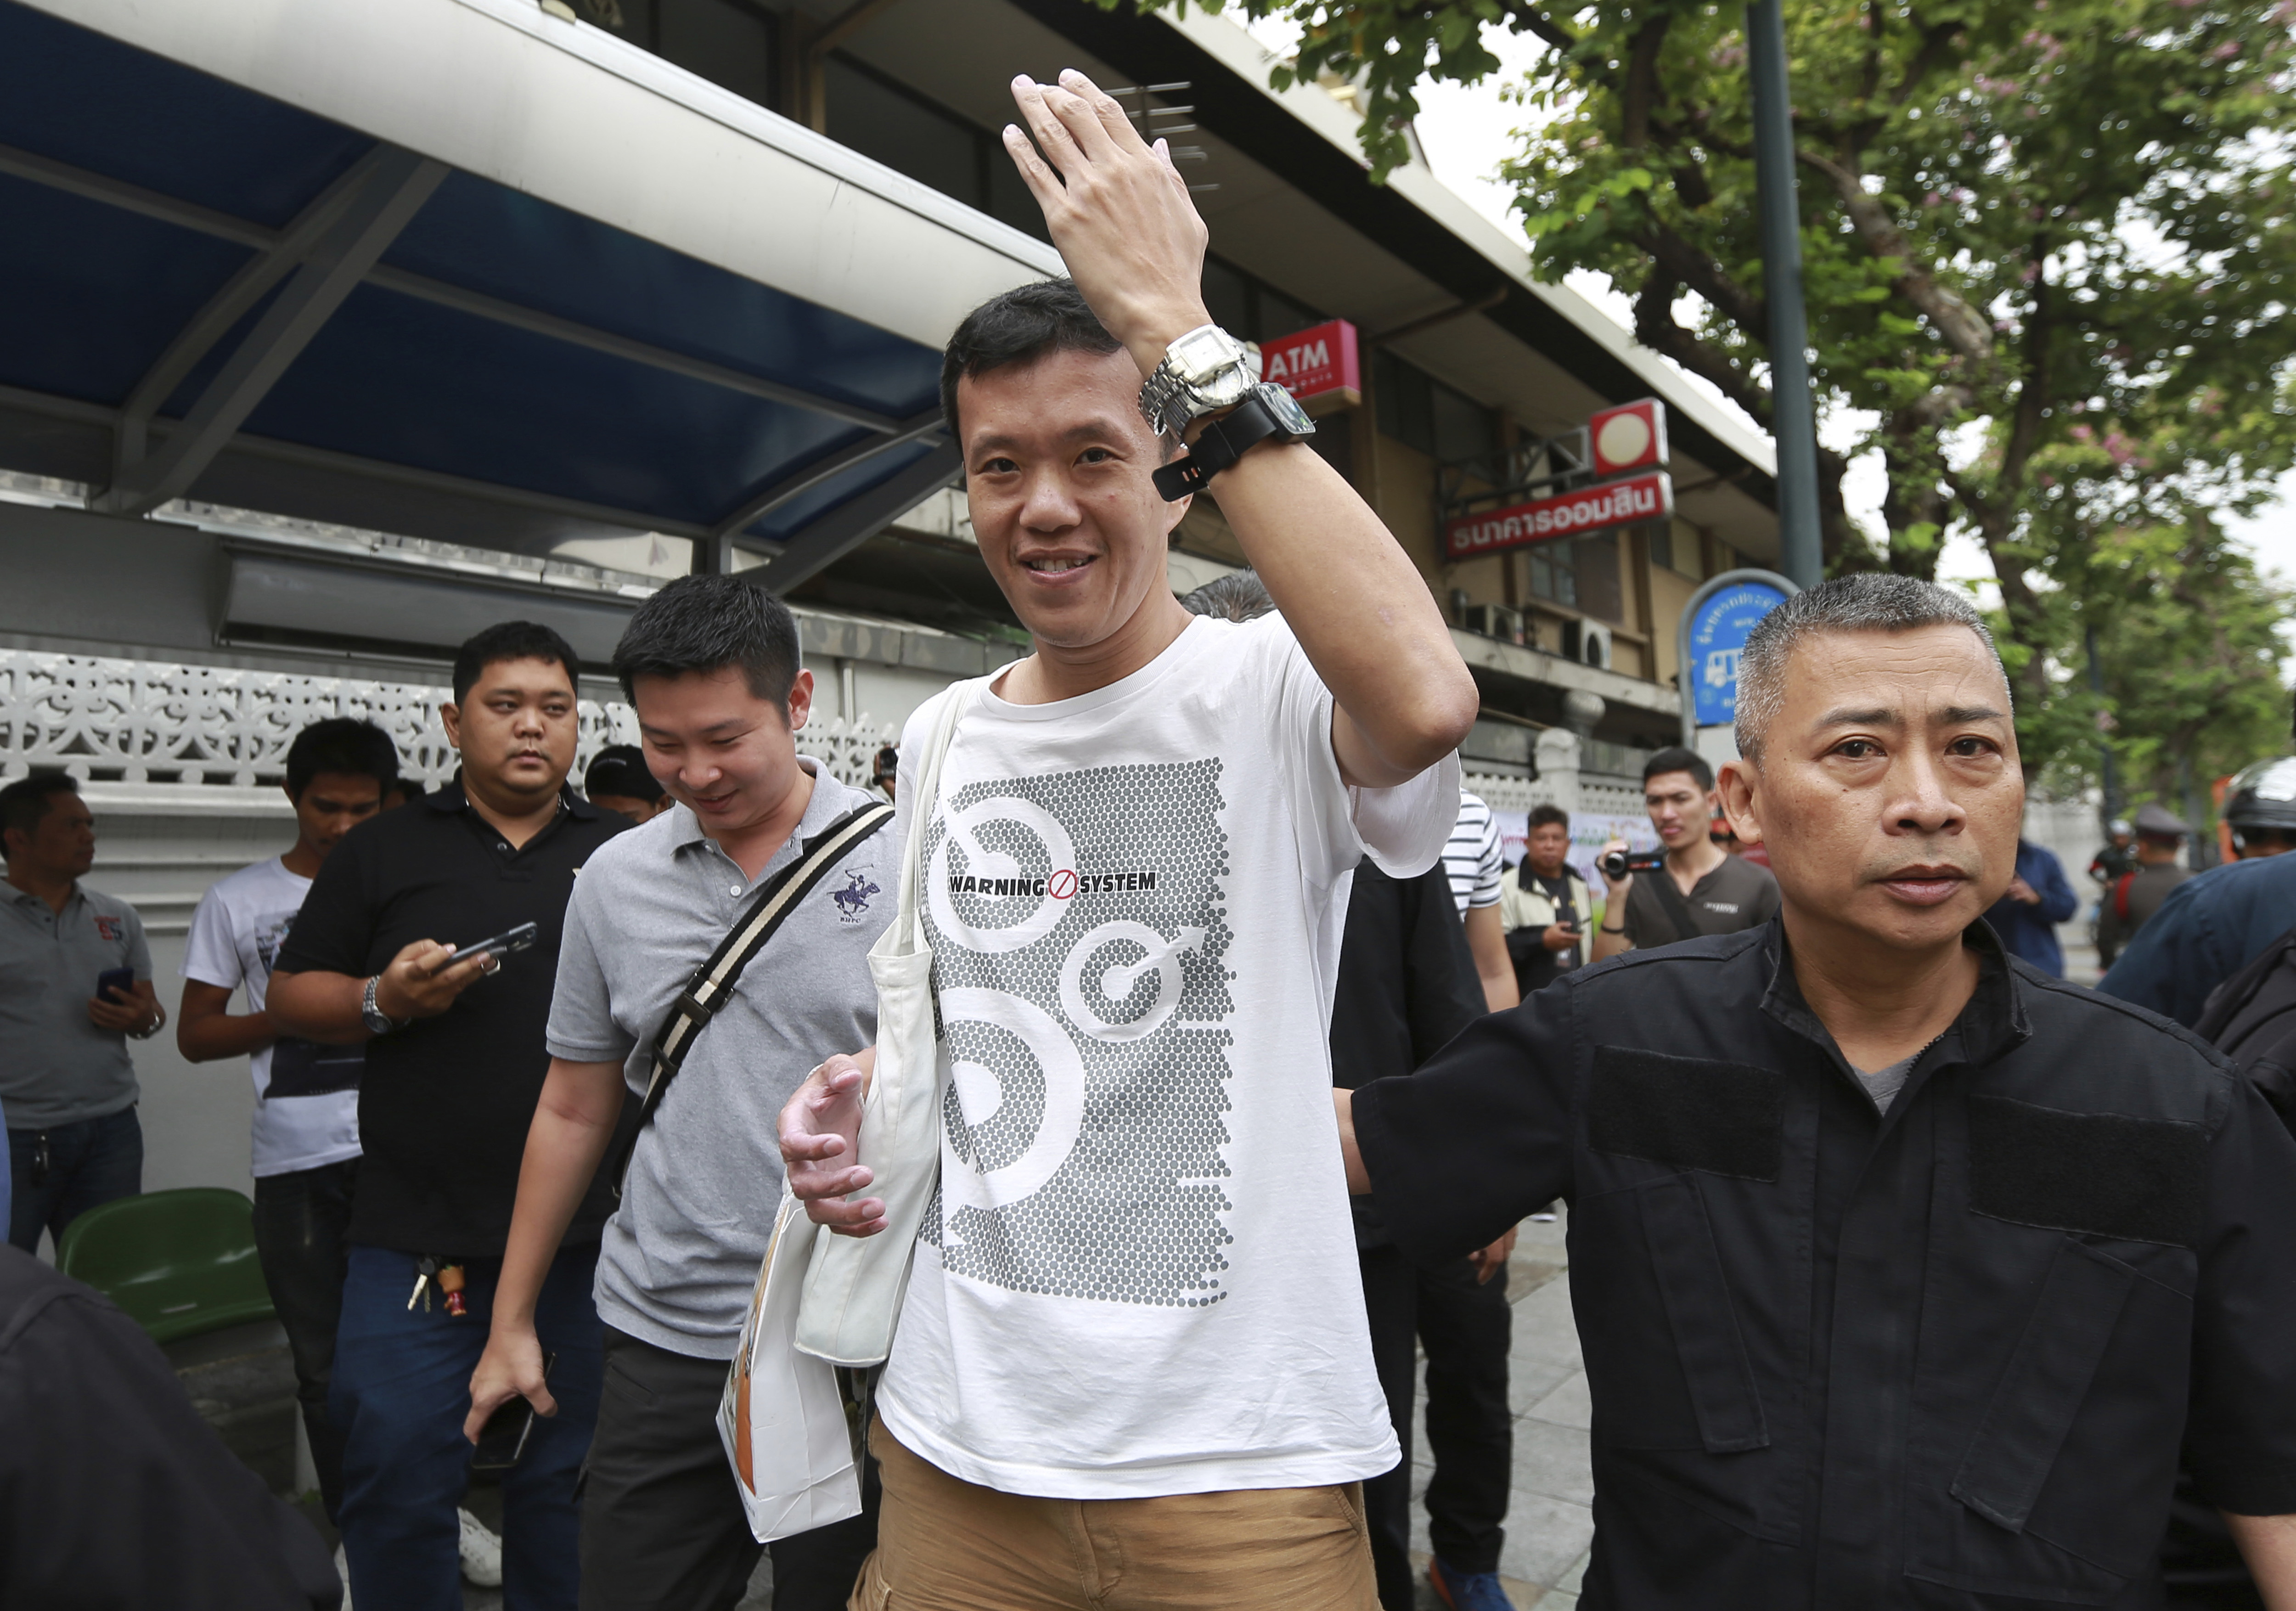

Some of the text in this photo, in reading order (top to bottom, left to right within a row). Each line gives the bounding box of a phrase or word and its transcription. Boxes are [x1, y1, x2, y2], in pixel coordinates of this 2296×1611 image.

[1267, 339, 1330, 382] ATM
[1453, 486, 1656, 548] ธนาคารออมสิน
[950, 872, 1156, 896] WARNING SYSTEM
